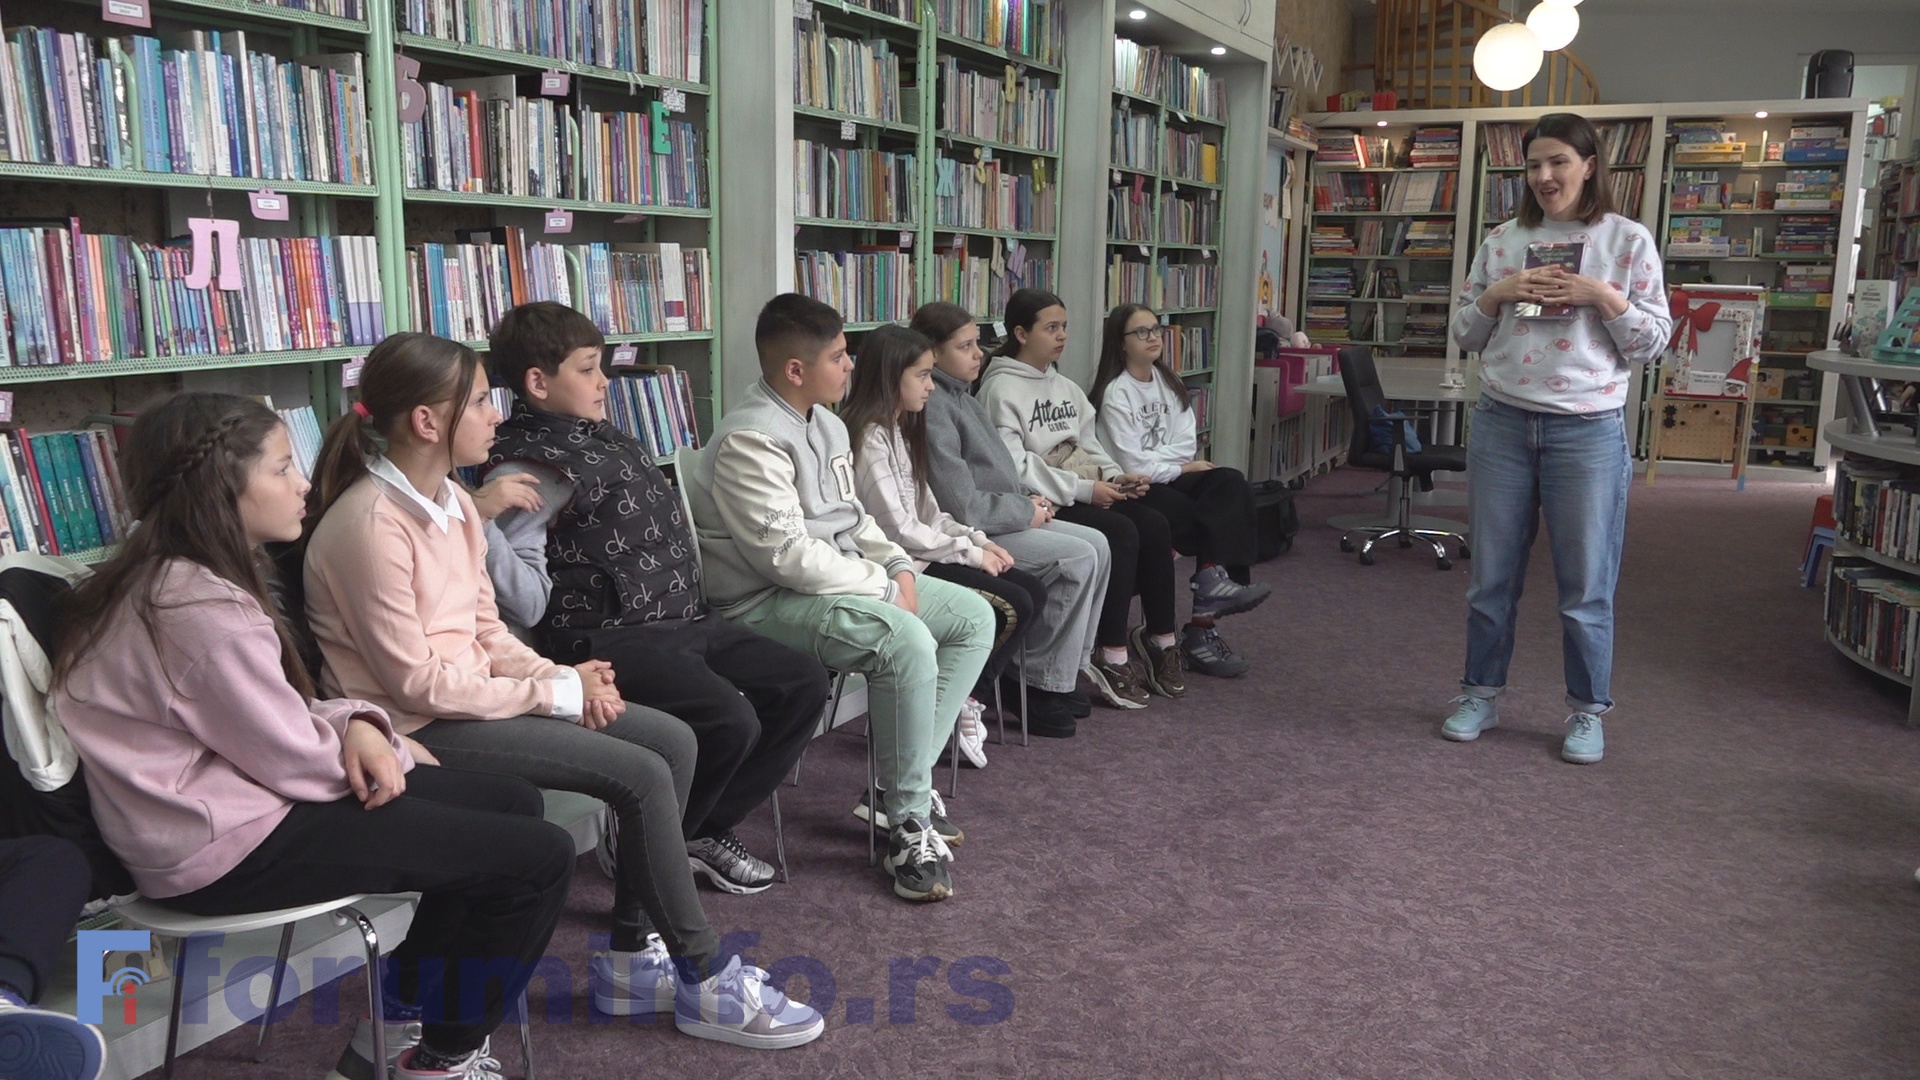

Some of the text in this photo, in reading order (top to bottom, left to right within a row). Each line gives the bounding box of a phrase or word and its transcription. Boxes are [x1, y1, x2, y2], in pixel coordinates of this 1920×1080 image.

[395, 54, 426, 123] Б
[651, 100, 671, 155] Е
[936, 158, 955, 197] Ж
[183, 217, 242, 290] Л
[1029, 398, 1077, 432] Atlanta
[620, 459, 639, 480] ck
[589, 476, 610, 502] ck
[617, 488, 640, 515] ck
[644, 515, 662, 541] ck
[563, 540, 589, 563] ck
[605, 528, 630, 555] ck
[639, 551, 661, 570] ck
[669, 569, 687, 593] ck
[633, 583, 652, 609] ck
[552, 613, 570, 628] ck
